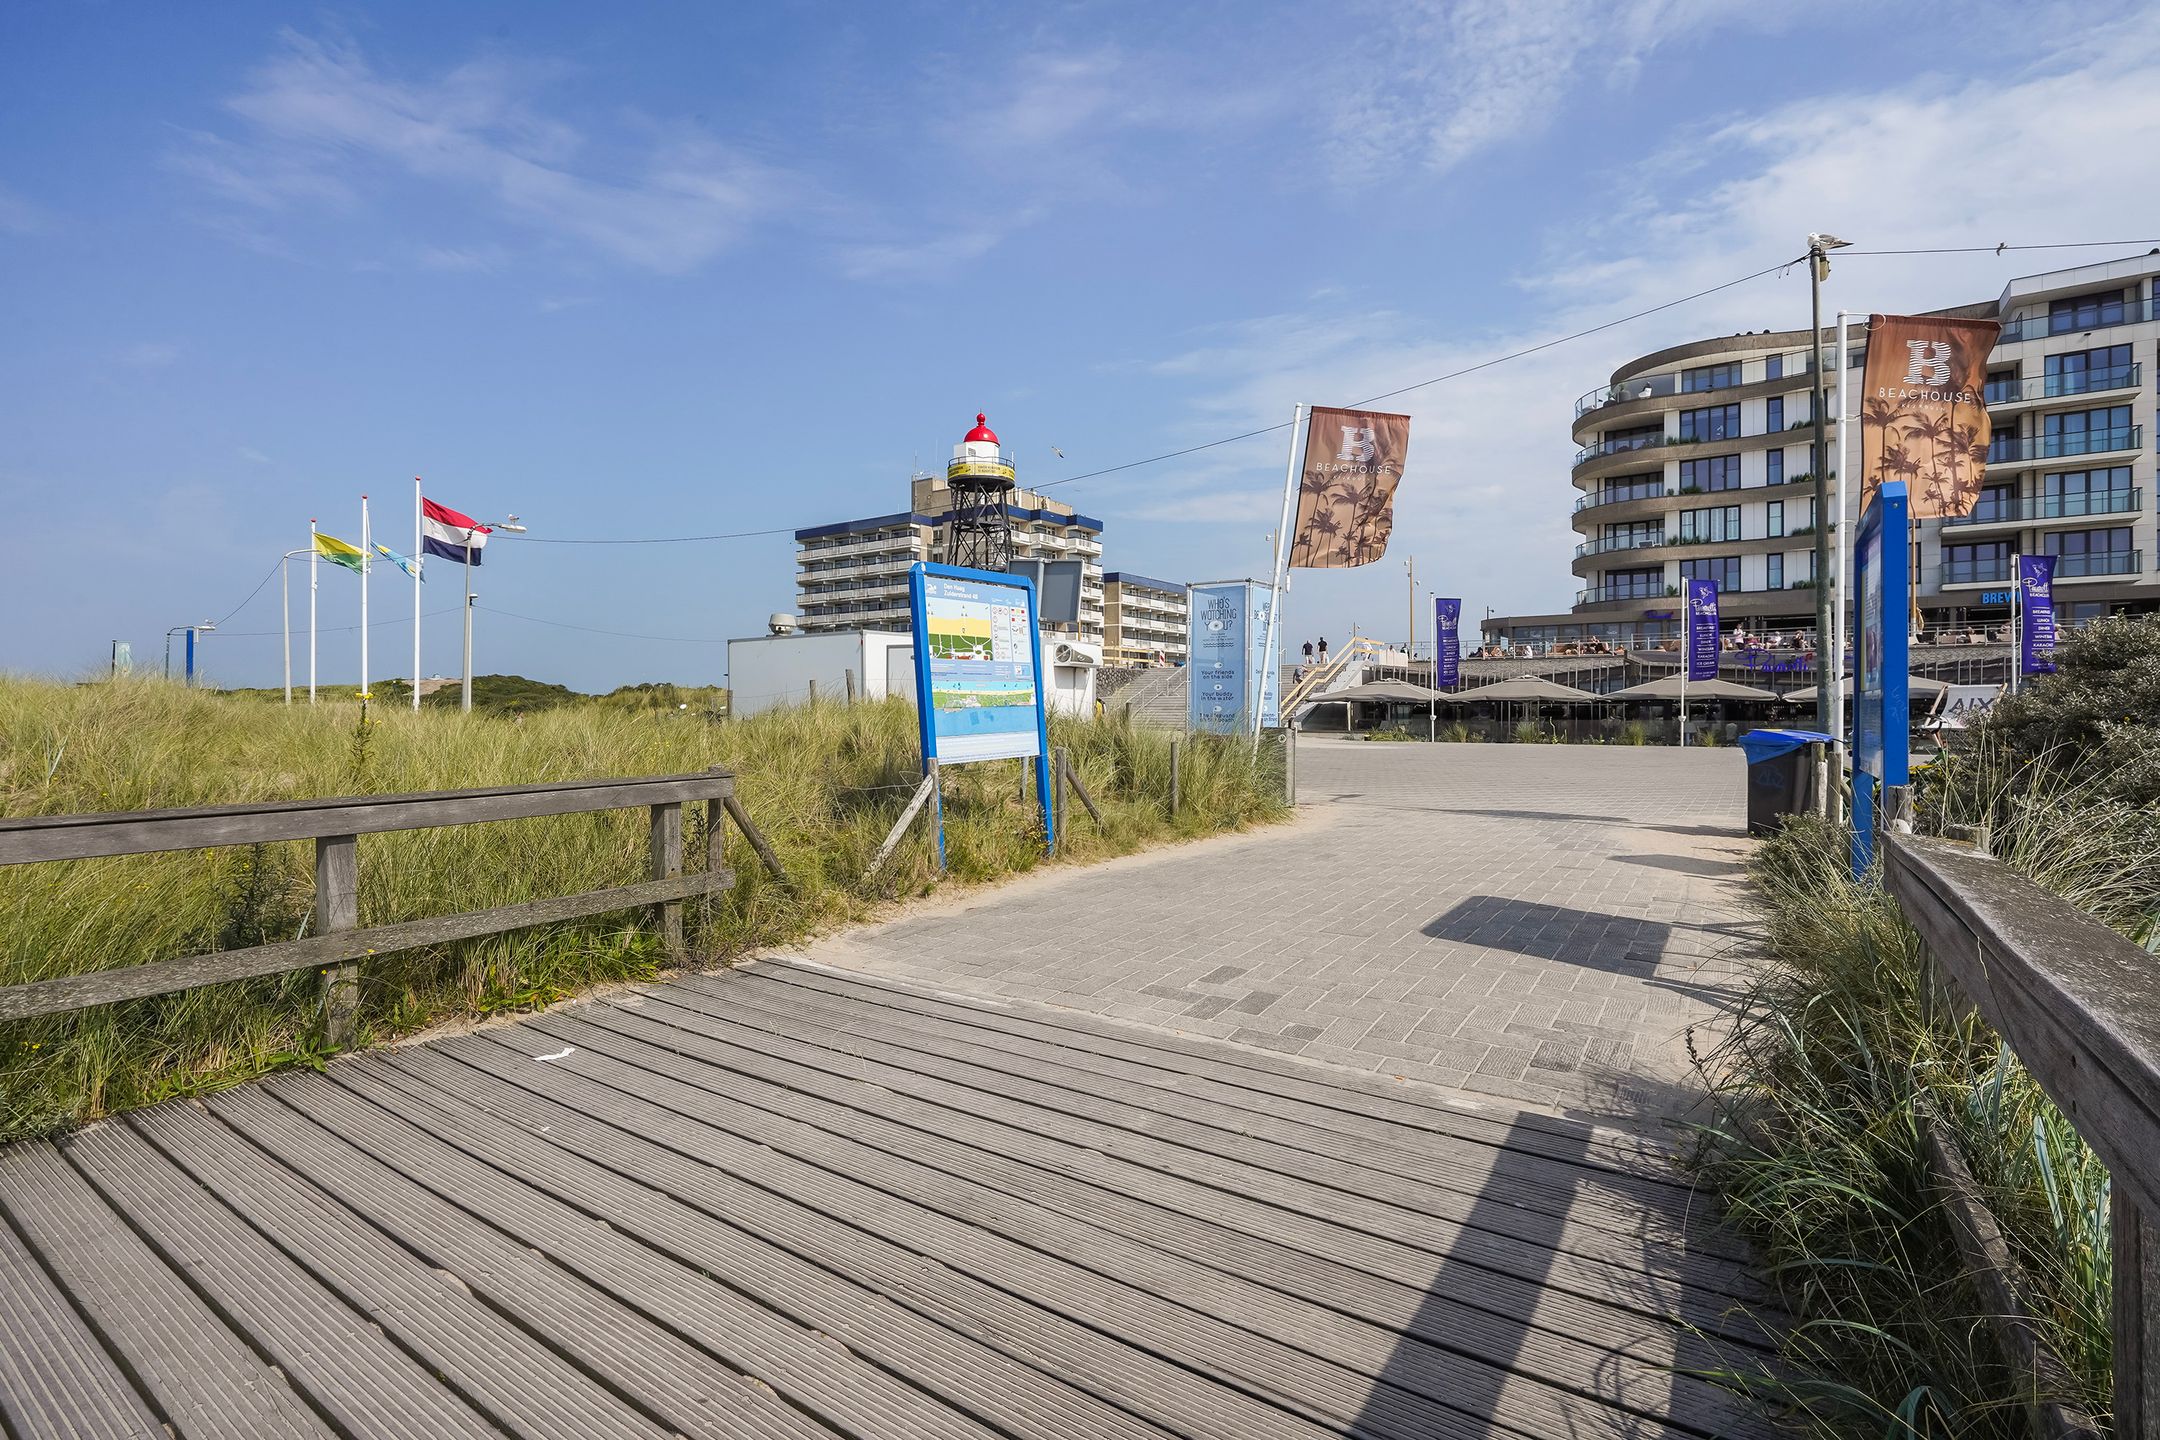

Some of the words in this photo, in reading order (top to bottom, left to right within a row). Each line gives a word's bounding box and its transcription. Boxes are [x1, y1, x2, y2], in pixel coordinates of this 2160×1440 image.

[1879, 387, 1971, 404] BEACHOUSE
[1316, 462, 1392, 475] BEACHOUSE
[1207, 596, 1230, 609] WHO'S
